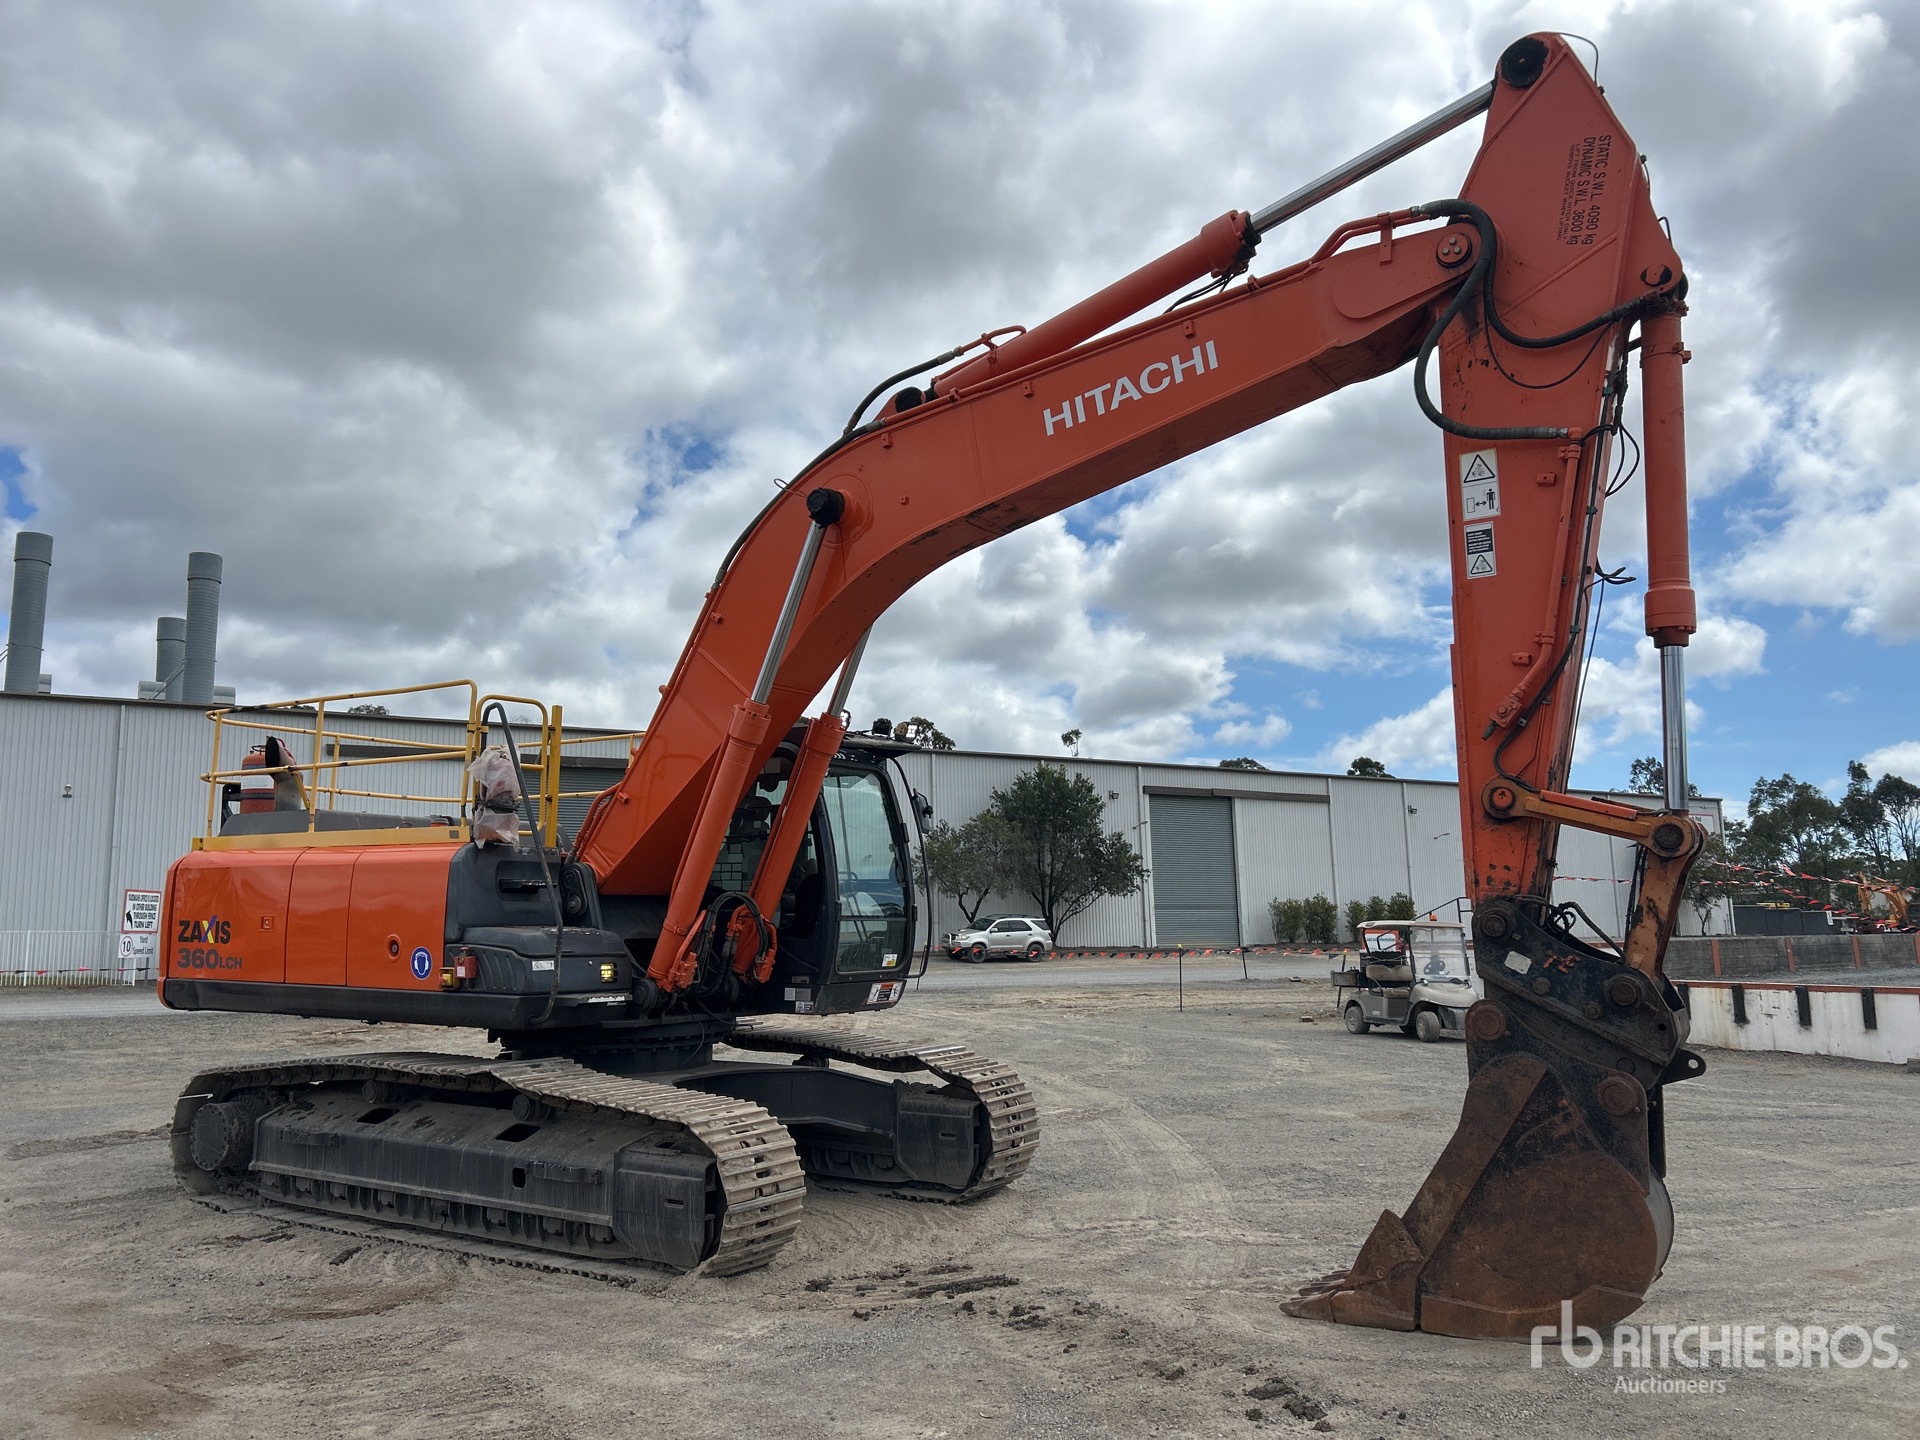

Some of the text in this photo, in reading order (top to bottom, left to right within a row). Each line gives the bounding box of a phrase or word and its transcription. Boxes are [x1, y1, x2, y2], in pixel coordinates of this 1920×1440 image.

[1567, 137, 1595, 245] DYNAMIC S.W.L. 3600 kg
[1582, 134, 1611, 244] STATIC S.W.L. 4090 kg
[1042, 338, 1220, 436] HITACHI
[123, 940, 131, 952] 10
[132, 947, 144, 955] Speed
[178, 914, 231, 944] ZAXIS
